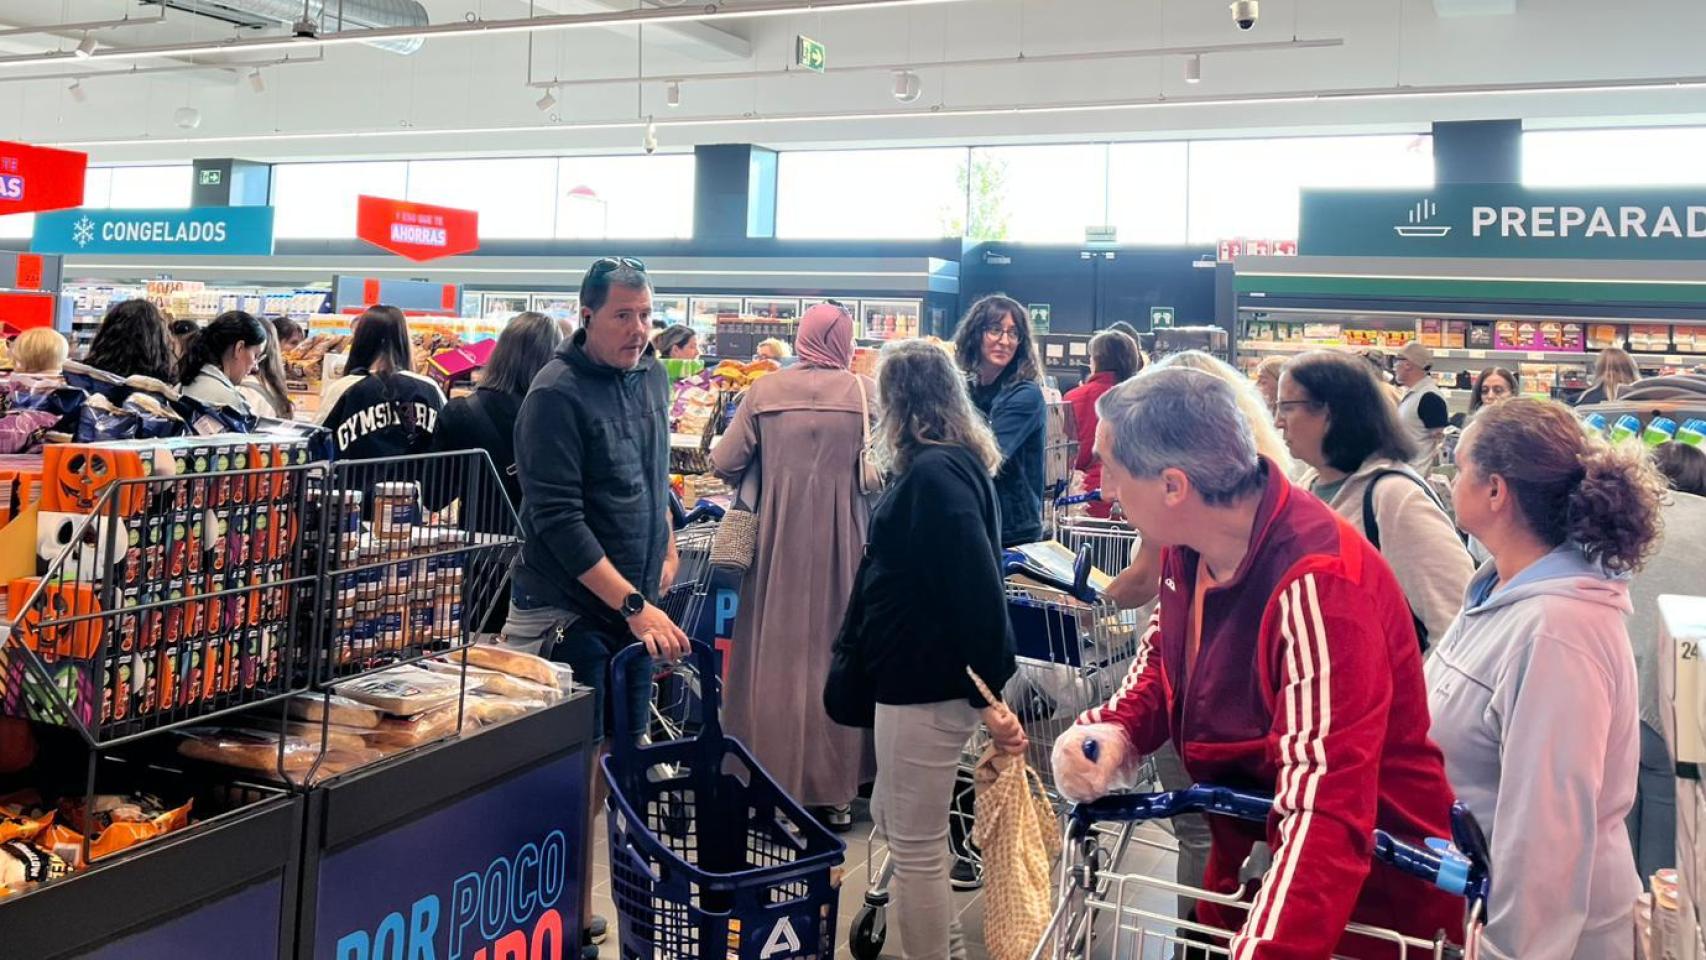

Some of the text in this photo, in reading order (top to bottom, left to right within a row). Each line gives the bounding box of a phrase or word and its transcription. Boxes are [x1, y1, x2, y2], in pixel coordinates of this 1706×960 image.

[102, 221, 226, 241] CONGELADOS
[391, 224, 446, 245] AHORRAS
[1472, 206, 1706, 237] PREPARAD
[449, 829, 566, 960] POCO
